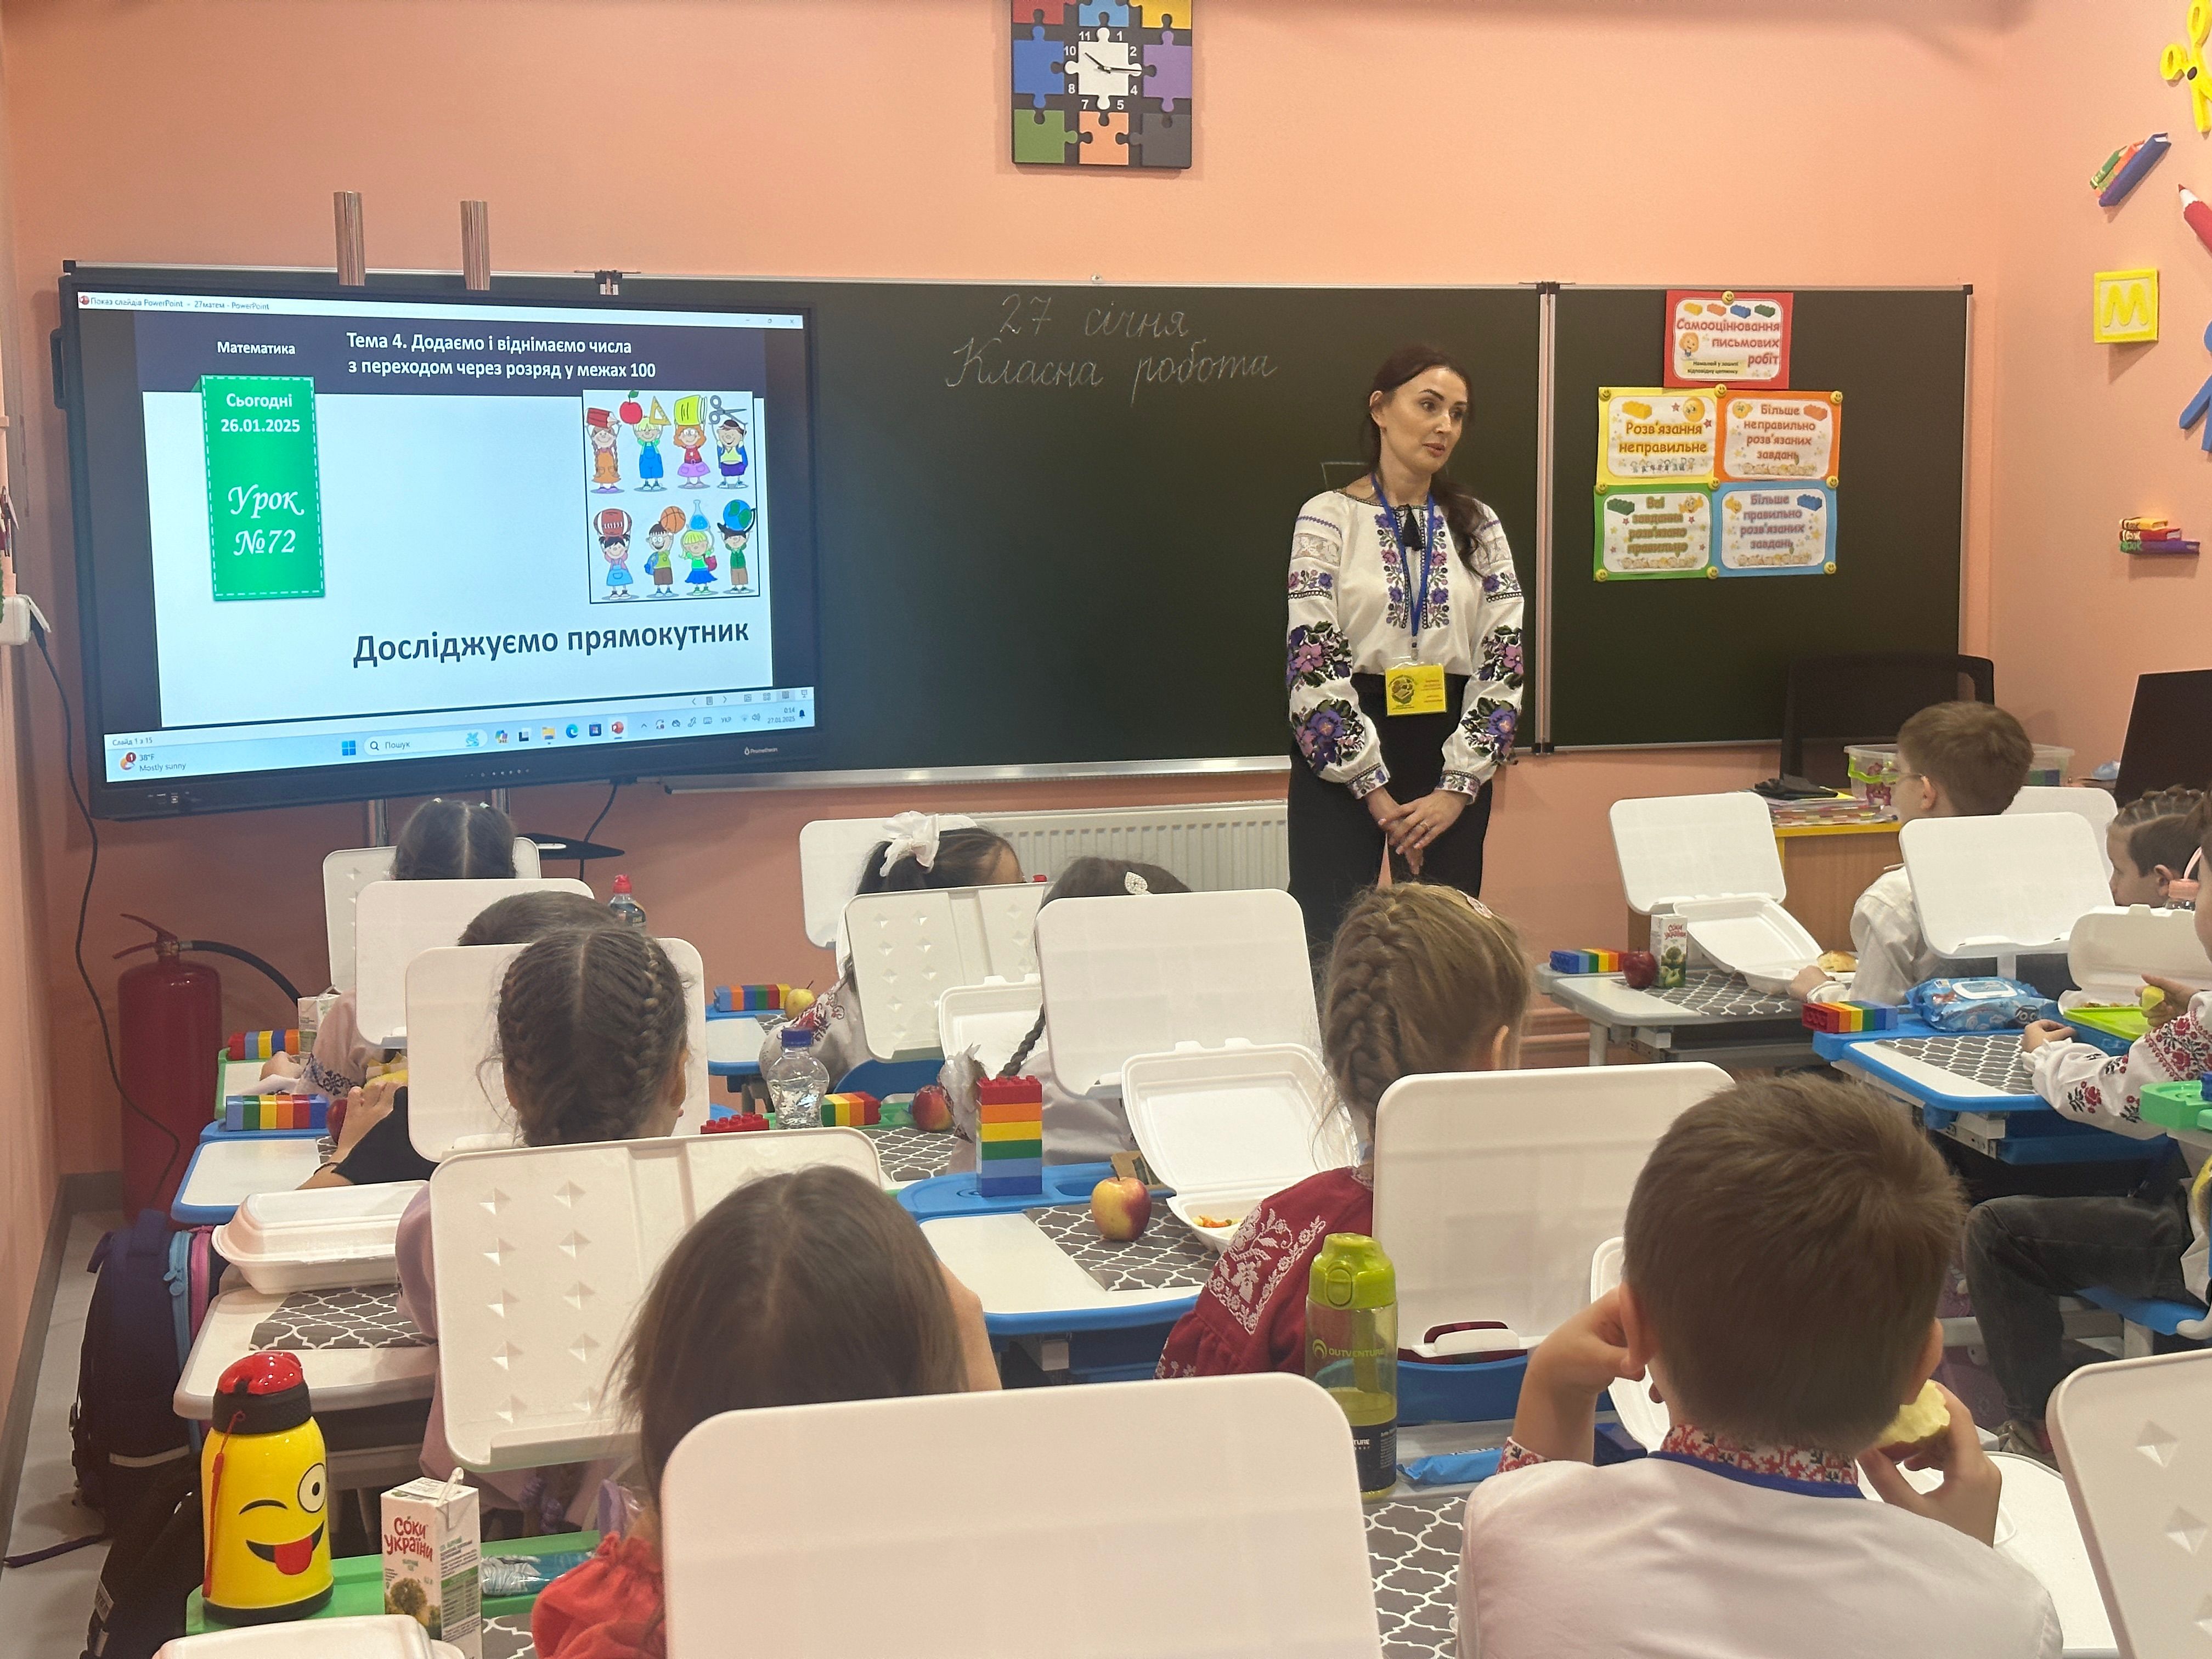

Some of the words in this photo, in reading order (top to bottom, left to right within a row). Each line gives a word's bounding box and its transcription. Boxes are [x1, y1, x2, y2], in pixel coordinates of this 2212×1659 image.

[1079, 31, 1091, 41] 11
[1116, 31, 1122, 41] 1
[1064, 46, 1076, 56] 10
[1130, 47, 1137, 56] 2
[1068, 84, 1075, 94] 8
[1130, 86, 1138, 95] 4
[1081, 100, 1088, 109] 7
[1117, 100, 1124, 110] 5
[144, 299, 183, 307] PowerPoint
[232, 301, 269, 310] PowerPoint
[1000, 294, 1052, 335] 27
[1085, 301, 1189, 338] січня
[1677, 317, 1780, 332] Самооцінювання
[217, 340, 296, 356] Математика
[346, 332, 388, 349] Тема
[392, 334, 408, 349] 4.
[411, 334, 485, 352] Додаємо
[489, 336, 494, 351] і
[497, 336, 586, 354] віднімаємо
[589, 340, 632, 354] числа
[1711, 338, 1780, 348] письмових
[1748, 352, 1779, 368] робіт
[348, 362, 357, 373] з
[361, 362, 453, 378] переходом
[456, 363, 502, 378] через
[506, 364, 562, 380] розряд
[565, 365, 573, 380] у
[577, 365, 627, 378] межах
[630, 363, 656, 378] 100
[945, 337, 1104, 388] Класна
[1131, 338, 1279, 407] робота
[226, 393, 293, 409] Сьогодні
[1760, 404, 1800, 415] Більше
[220, 418, 301, 433] 26.01.2025
[1626, 420, 1702, 435] Розв'язання
[1743, 420, 1816, 432] неправильно
[1746, 433, 1812, 447] розв'язаних
[1619, 443, 1707, 456] неправильне
[1757, 450, 1799, 460] завдань
[228, 483, 305, 519] Урок
[1750, 493, 1790, 505] Більше
[1743, 509, 1803, 523] правильно
[1740, 522, 1805, 538] розв'язаних
[233, 528, 297, 556] №72
[1750, 538, 1794, 550] завдань
[353, 631, 558, 668] Досліджуємо
[568, 620, 749, 653] прямокутник
[385, 741, 410, 749] Пошук
[139, 764, 163, 772] Mostly
[165, 763, 187, 771] sunny
[1328, 1347, 1385, 1358] OUTVENTURE
